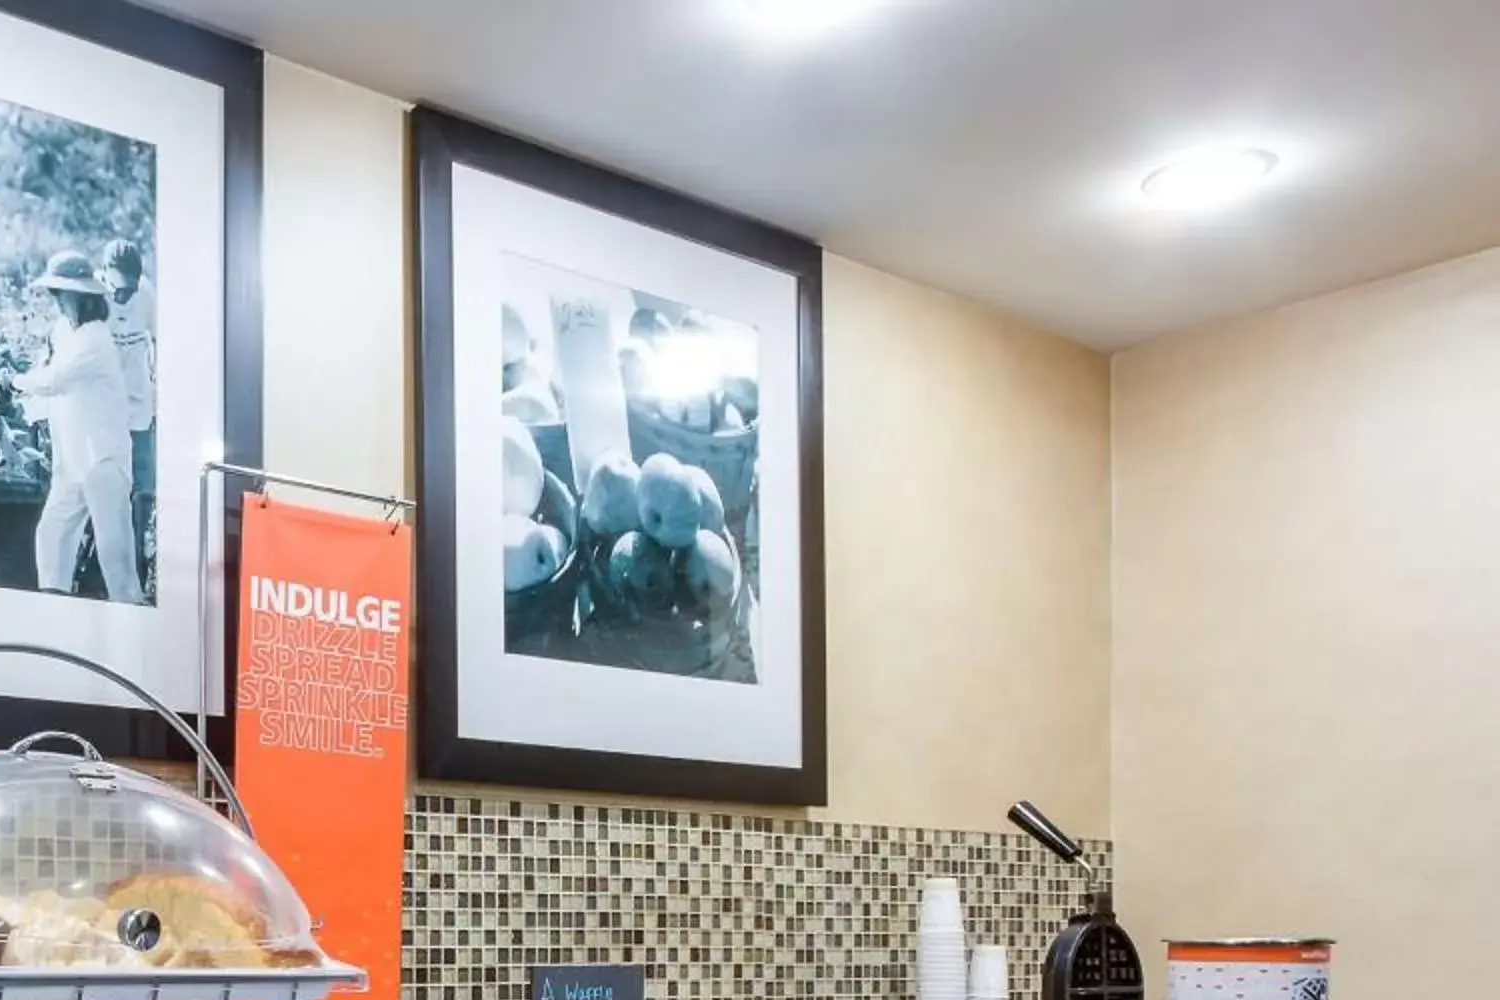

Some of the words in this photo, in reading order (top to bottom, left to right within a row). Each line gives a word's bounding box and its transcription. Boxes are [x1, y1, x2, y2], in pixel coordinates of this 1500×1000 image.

[250, 575, 401, 633] INDULGE
[252, 609, 397, 665] DRIZZLE
[250, 644, 395, 693] SPREAD
[237, 672, 407, 729] SPRINKLE
[260, 711, 384, 758] SMILE.
